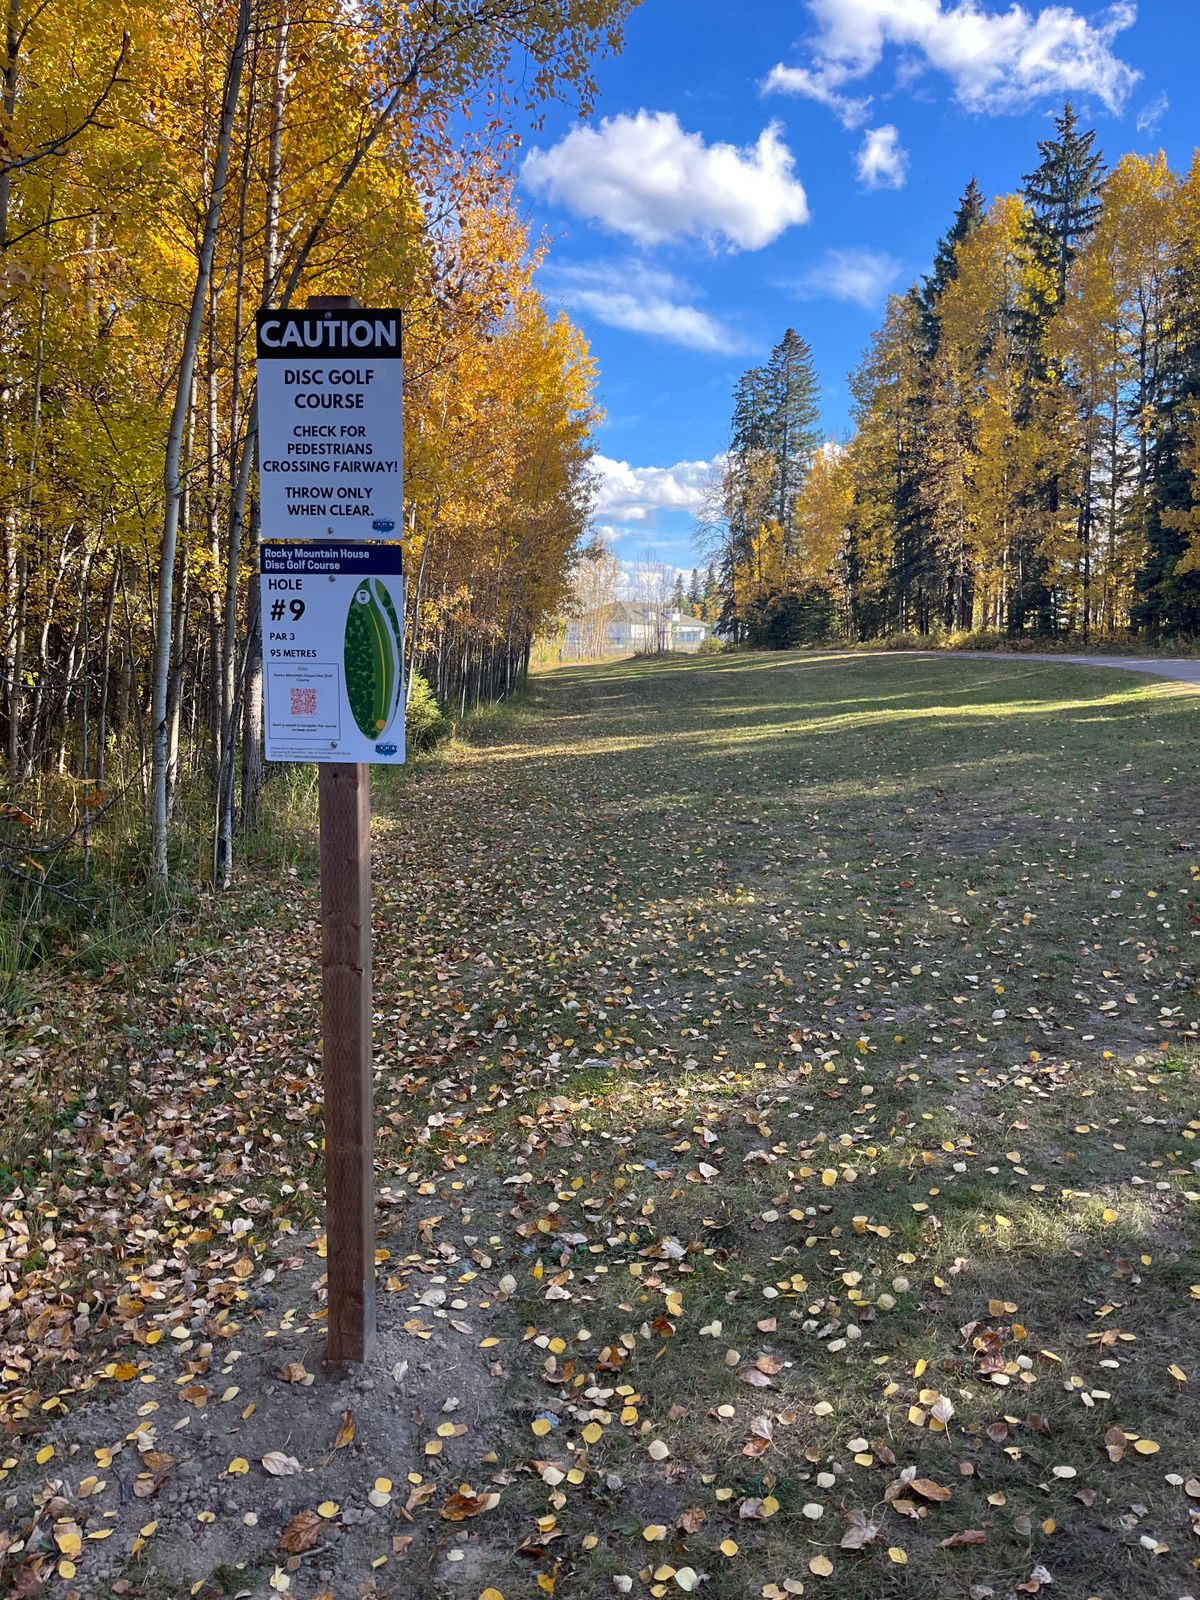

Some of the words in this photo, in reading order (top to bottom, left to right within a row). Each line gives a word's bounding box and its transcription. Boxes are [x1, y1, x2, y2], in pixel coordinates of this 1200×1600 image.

[260, 319, 396, 348] CAUTION
[284, 369, 324, 385] DISC
[328, 369, 374, 385] GOLF
[294, 393, 364, 409] COURSE
[293, 425, 337, 437] CHECK
[340, 425, 366, 437] FOR
[287, 443, 373, 455] PEDESTRIANS
[263, 461, 330, 472] CROSSING
[333, 461, 398, 473] FAIRWAY!
[285, 487, 334, 499] THROW
[337, 487, 373, 499] ONLY
[287, 504, 326, 516] WHEN
[329, 504, 374, 516] CLEAR.
[264, 548, 293, 560] Rocky
[294, 548, 339, 558] Mountain
[340, 549, 370, 559] House
[265, 560, 286, 570] Disc
[286, 560, 306, 570] Golf
[307, 560, 341, 570] Course
[268, 578, 303, 590] HOLE
[270, 599, 306, 621] #9
[269, 632, 288, 641] PAR
[289, 632, 296, 641] 3
[270, 649, 281, 657] 95
[283, 649, 317, 658] METRES
